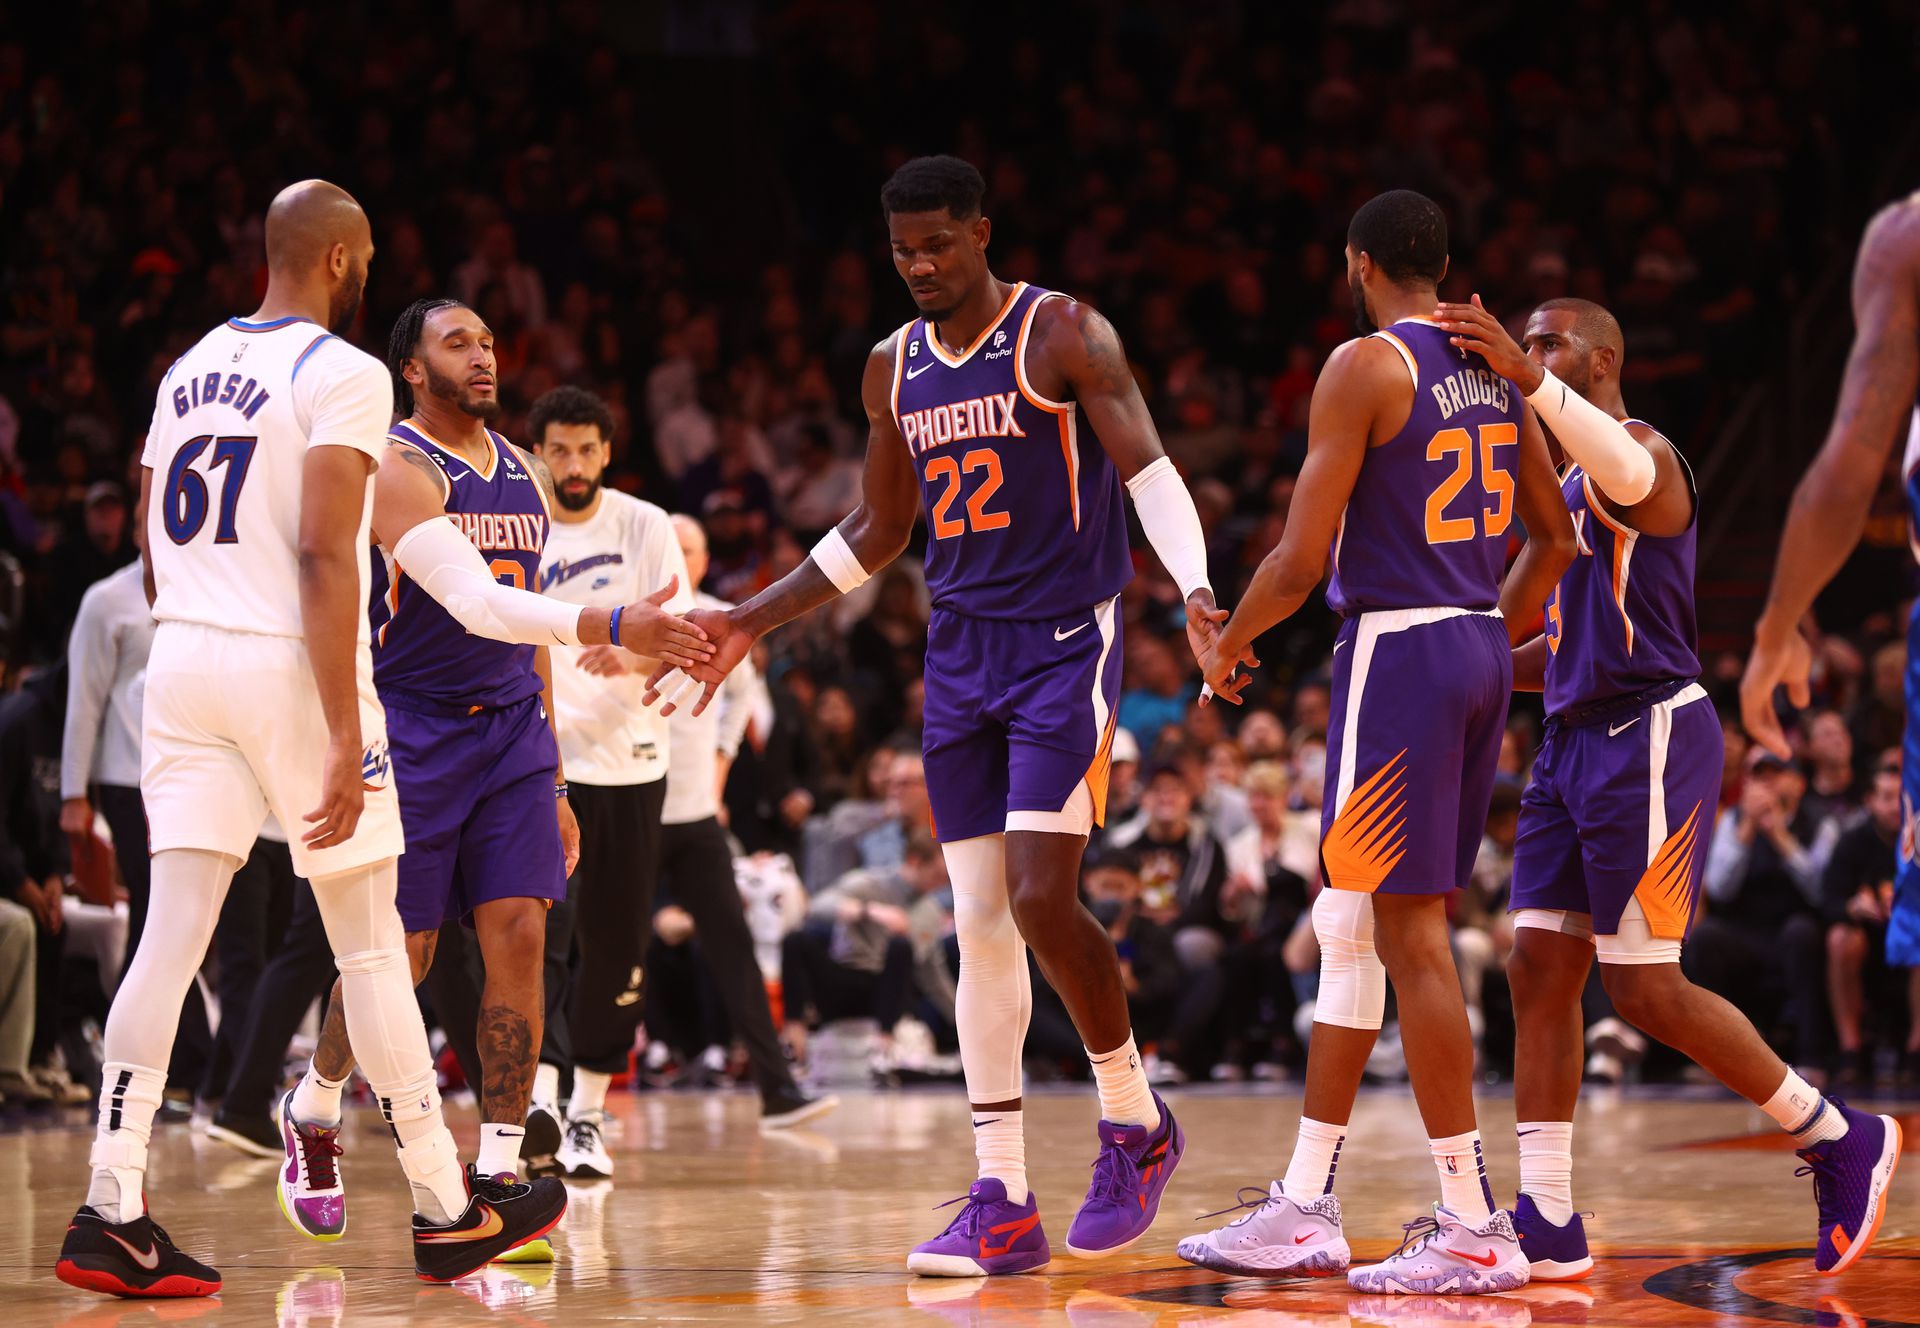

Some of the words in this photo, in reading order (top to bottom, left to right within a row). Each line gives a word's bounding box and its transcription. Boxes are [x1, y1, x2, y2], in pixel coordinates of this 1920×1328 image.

[909, 340, 920, 358] 6
[985, 347, 1013, 361] PayPal
[172, 372, 270, 421] GIBSON
[1431, 368, 1510, 420] BRIDGES
[900, 391, 1027, 460] PHOENIX
[163, 434, 258, 546] 67
[924, 447, 1011, 540] 22
[1425, 422, 1519, 545] 25
